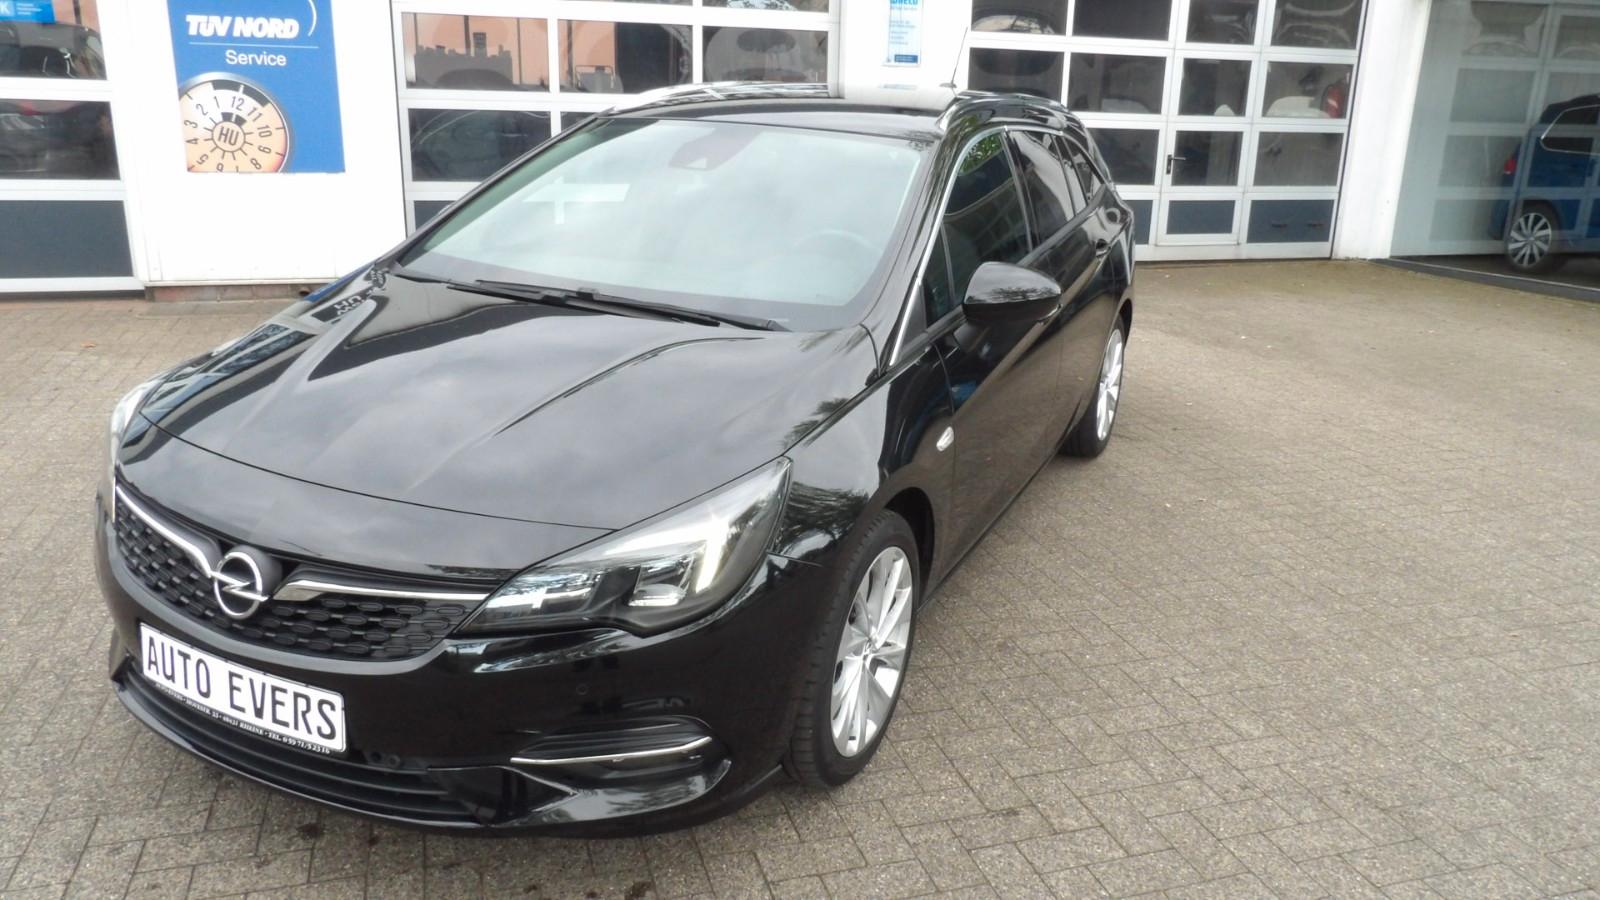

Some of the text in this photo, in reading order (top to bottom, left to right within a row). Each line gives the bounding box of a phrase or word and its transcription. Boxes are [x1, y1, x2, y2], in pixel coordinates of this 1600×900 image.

[233, 17, 299, 39] NORD
[225, 49, 287, 66] Service
[195, 103, 209, 116] 2
[213, 96, 220, 109] 1
[231, 96, 245, 111] 12
[247, 107, 263, 122] 11
[183, 119, 198, 129] 3
[257, 124, 272, 138] 10
[217, 126, 239, 146] HU
[196, 154, 209, 165] 5
[250, 158, 262, 170] 8
[148, 636, 337, 740] AUTO EVERS
